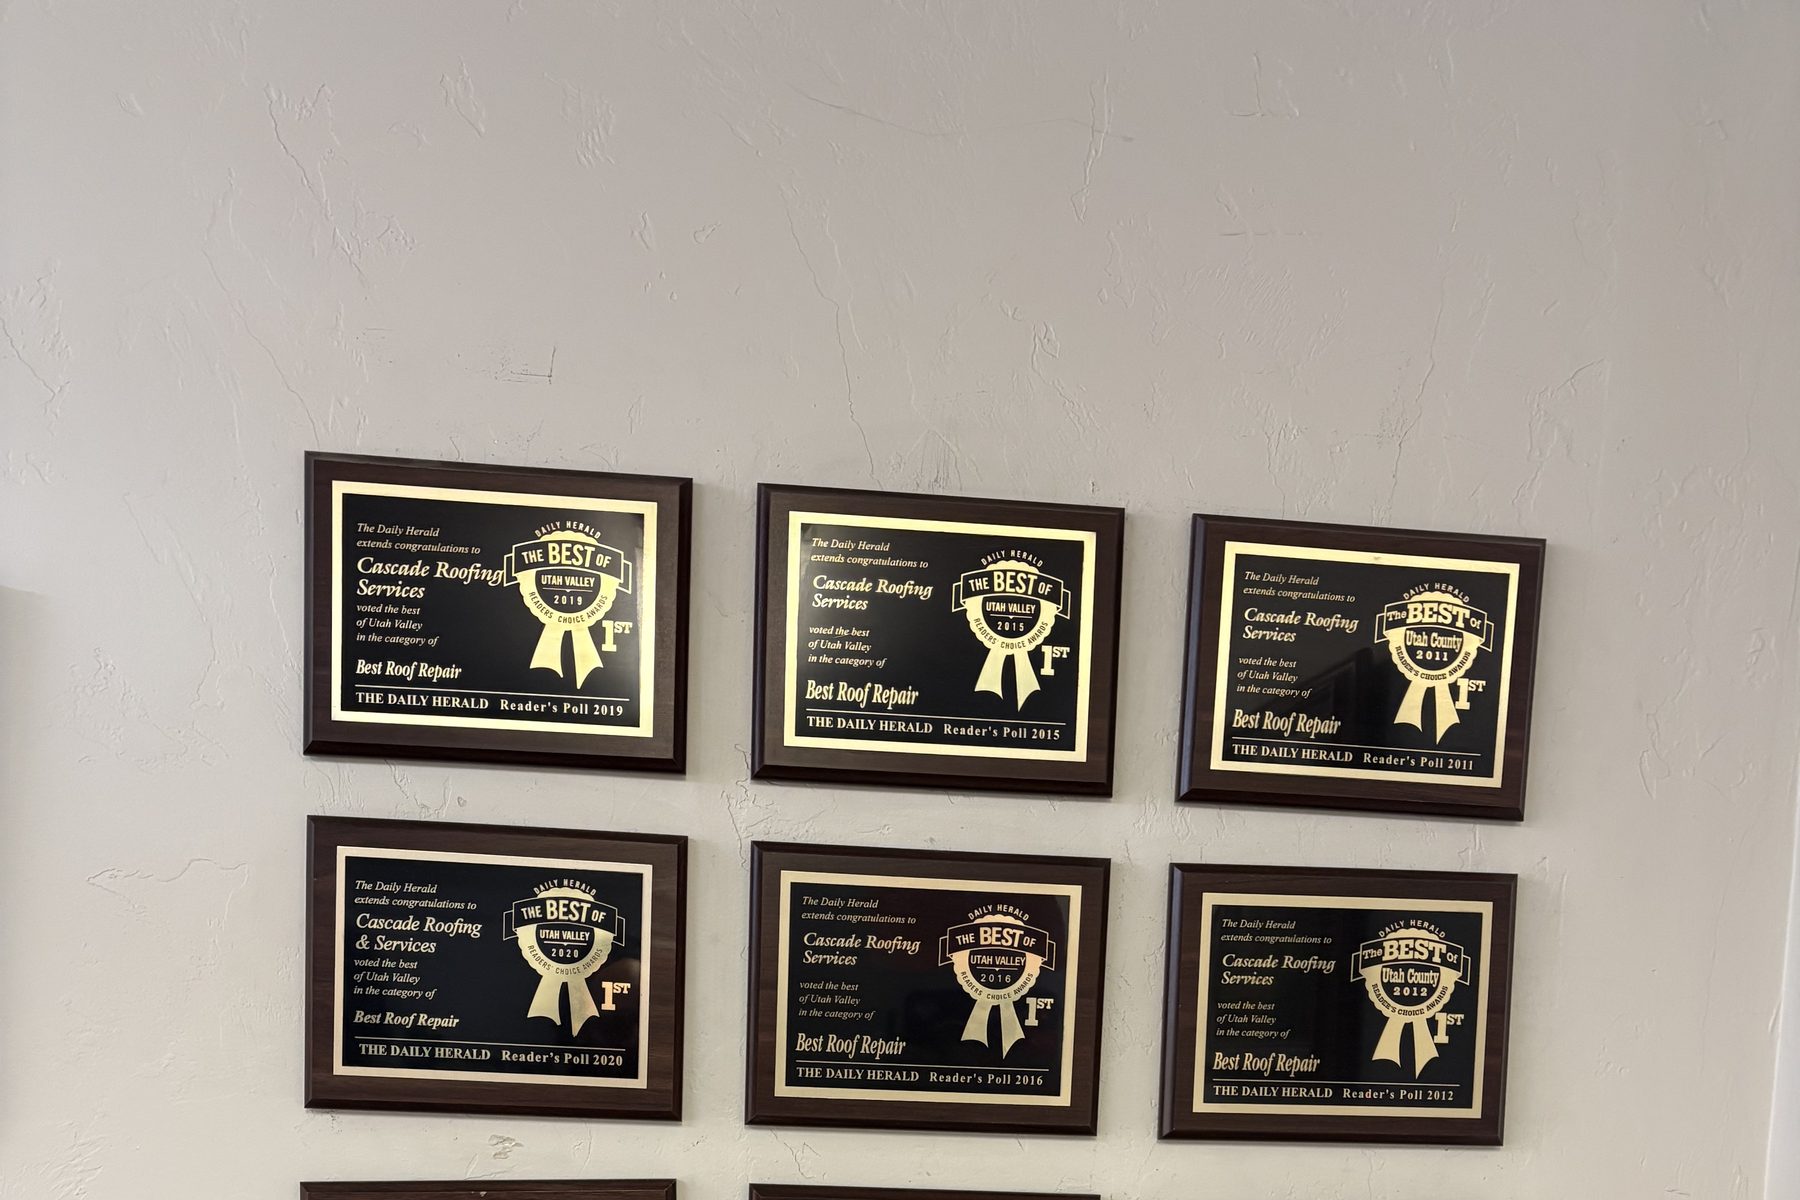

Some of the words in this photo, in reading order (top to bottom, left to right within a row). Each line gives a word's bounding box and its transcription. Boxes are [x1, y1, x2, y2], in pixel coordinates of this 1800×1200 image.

[357, 522, 375, 533] The
[376, 523, 404, 537] Daily
[405, 525, 440, 537] Herald
[534, 521, 561, 537] DAILY
[566, 521, 601, 539] HERALD
[356, 538, 392, 549] extends
[394, 542, 469, 554] congratulations
[470, 546, 481, 554] to
[521, 549, 544, 564] THE
[548, 542, 596, 568] BEST
[596, 554, 612, 568] OF
[356, 556, 430, 577] Cascade
[433, 561, 504, 587] Roofing
[541, 575, 563, 586] UTAH
[564, 576, 595, 588] VALLEY
[356, 578, 425, 599] Services
[812, 574, 873, 592] Cascade
[875, 578, 934, 600] Roofing
[356, 603, 383, 613] voted
[384, 604, 399, 614] the
[400, 604, 420, 615] best
[554, 595, 582, 605] 2019
[557, 614, 585, 624] CHOICE
[586, 594, 608, 619] AWARDS
[811, 592, 868, 610] Services
[355, 617, 368, 629] of
[368, 617, 392, 628] Utah
[394, 619, 423, 632] Valley
[1244, 607, 1302, 625] Cascade
[1303, 611, 1359, 634] Roofing
[1386, 610, 1407, 621] The
[1406, 602, 1471, 628] BEST
[356, 632, 366, 641] in
[367, 632, 383, 642] the
[384, 635, 426, 647] category
[427, 635, 440, 647] of
[601, 620, 633, 652] 1ST
[1242, 624, 1296, 642] Services
[1405, 630, 1428, 647] Utah
[1430, 632, 1463, 653] County
[1416, 650, 1448, 661] 2011
[355, 658, 383, 675] Best
[384, 660, 418, 681] Roof
[417, 662, 462, 682] Repair
[355, 691, 384, 704] THE
[387, 693, 429, 706] DAILY
[432, 695, 489, 709] HERALD
[500, 698, 558, 713] Reader's
[563, 702, 588, 715] Poll
[593, 703, 623, 716] 2019
[806, 715, 834, 728] THE
[836, 717, 876, 730] DAILY
[879, 719, 933, 733] HERALD
[943, 723, 998, 737] Reader's
[1003, 726, 1027, 739] Poll
[1031, 728, 1060, 740] 2015
[1232, 743, 1258, 756] THE
[1261, 745, 1299, 758] DAILY
[1301, 748, 1353, 762] HERALD
[1363, 752, 1415, 766] Reader's
[1420, 756, 1443, 768] Poll
[1447, 758, 1473, 770] 2011
[356, 912, 420, 931] Cascade
[422, 916, 482, 938] Roofing
[355, 934, 370, 950] &
[373, 934, 437, 953] Services
[803, 932, 862, 948] Cascade
[864, 934, 921, 955] Roofing
[802, 949, 858, 966] Services
[1222, 953, 1279, 968] Cascade
[1280, 955, 1336, 974] Roofing
[1220, 970, 1274, 985] Services
[358, 1043, 387, 1056] THE
[390, 1044, 432, 1057] DAILY
[434, 1046, 491, 1060] HERALD
[564, 1052, 589, 1065] Poll
[592, 1054, 623, 1066] 2020
[796, 1066, 822, 1078] THE
[825, 1067, 864, 1080] DAILY
[866, 1069, 919, 1081] HERALD
[929, 1071, 982, 1084] Reader's
[987, 1073, 1011, 1084] Poll
[1015, 1074, 1043, 1086] 2016
[1212, 1085, 1238, 1096] THE
[1241, 1085, 1279, 1097] DAILY
[1281, 1086, 1333, 1098] HERALD
[1342, 1088, 1395, 1099] Reader's
[1399, 1089, 1422, 1100] Poll
[1426, 1090, 1453, 1101] 2012
